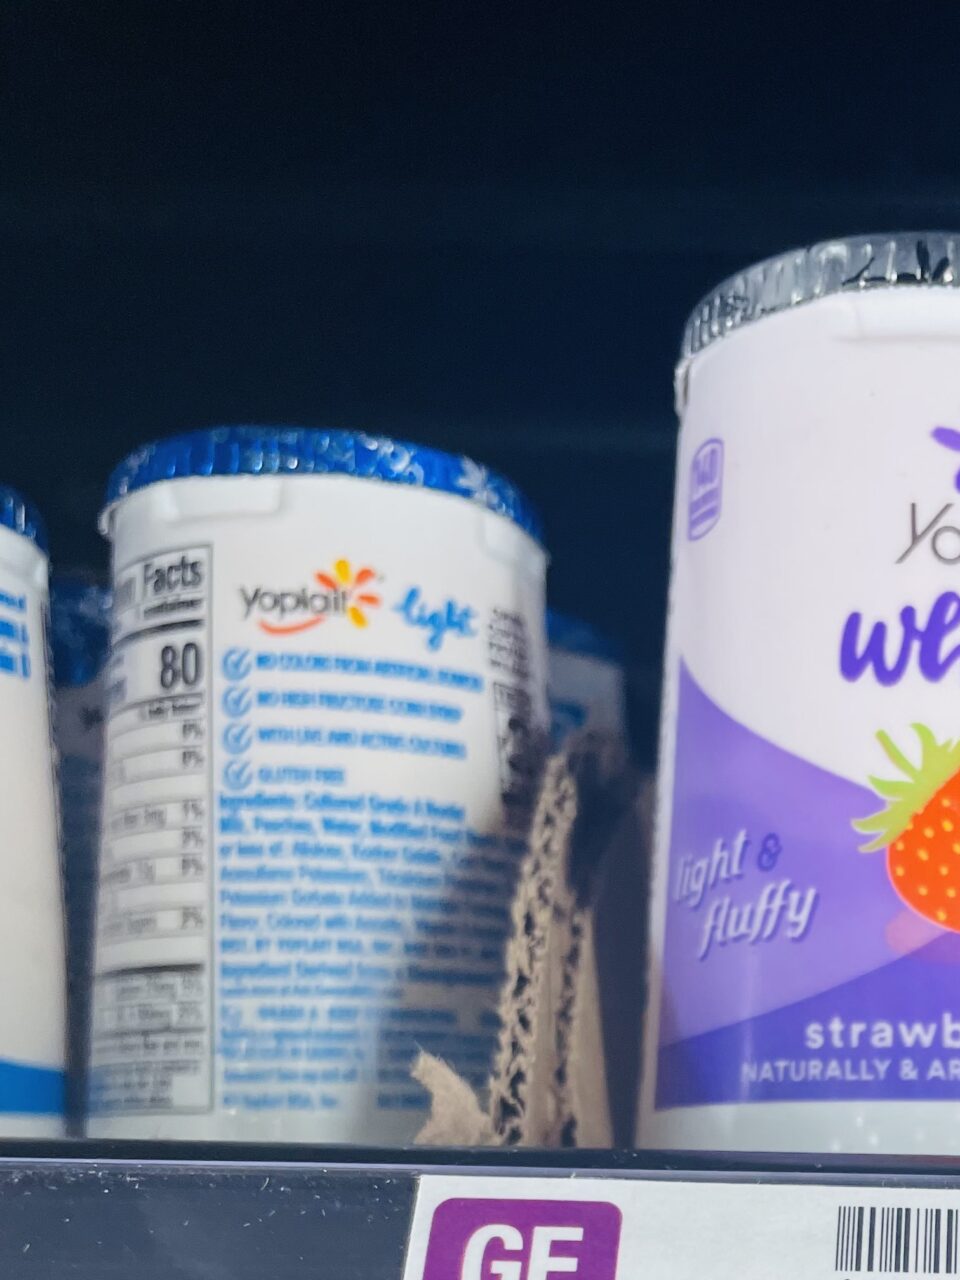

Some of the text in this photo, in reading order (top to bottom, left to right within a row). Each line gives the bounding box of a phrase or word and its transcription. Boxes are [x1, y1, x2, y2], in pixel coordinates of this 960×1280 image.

[161, 643, 199, 689] 80
[672, 829, 748, 908] light
[699, 879, 819, 961] fluffy
[741, 1058, 891, 1083] NATURALLY
[899, 1058, 919, 1080] &
